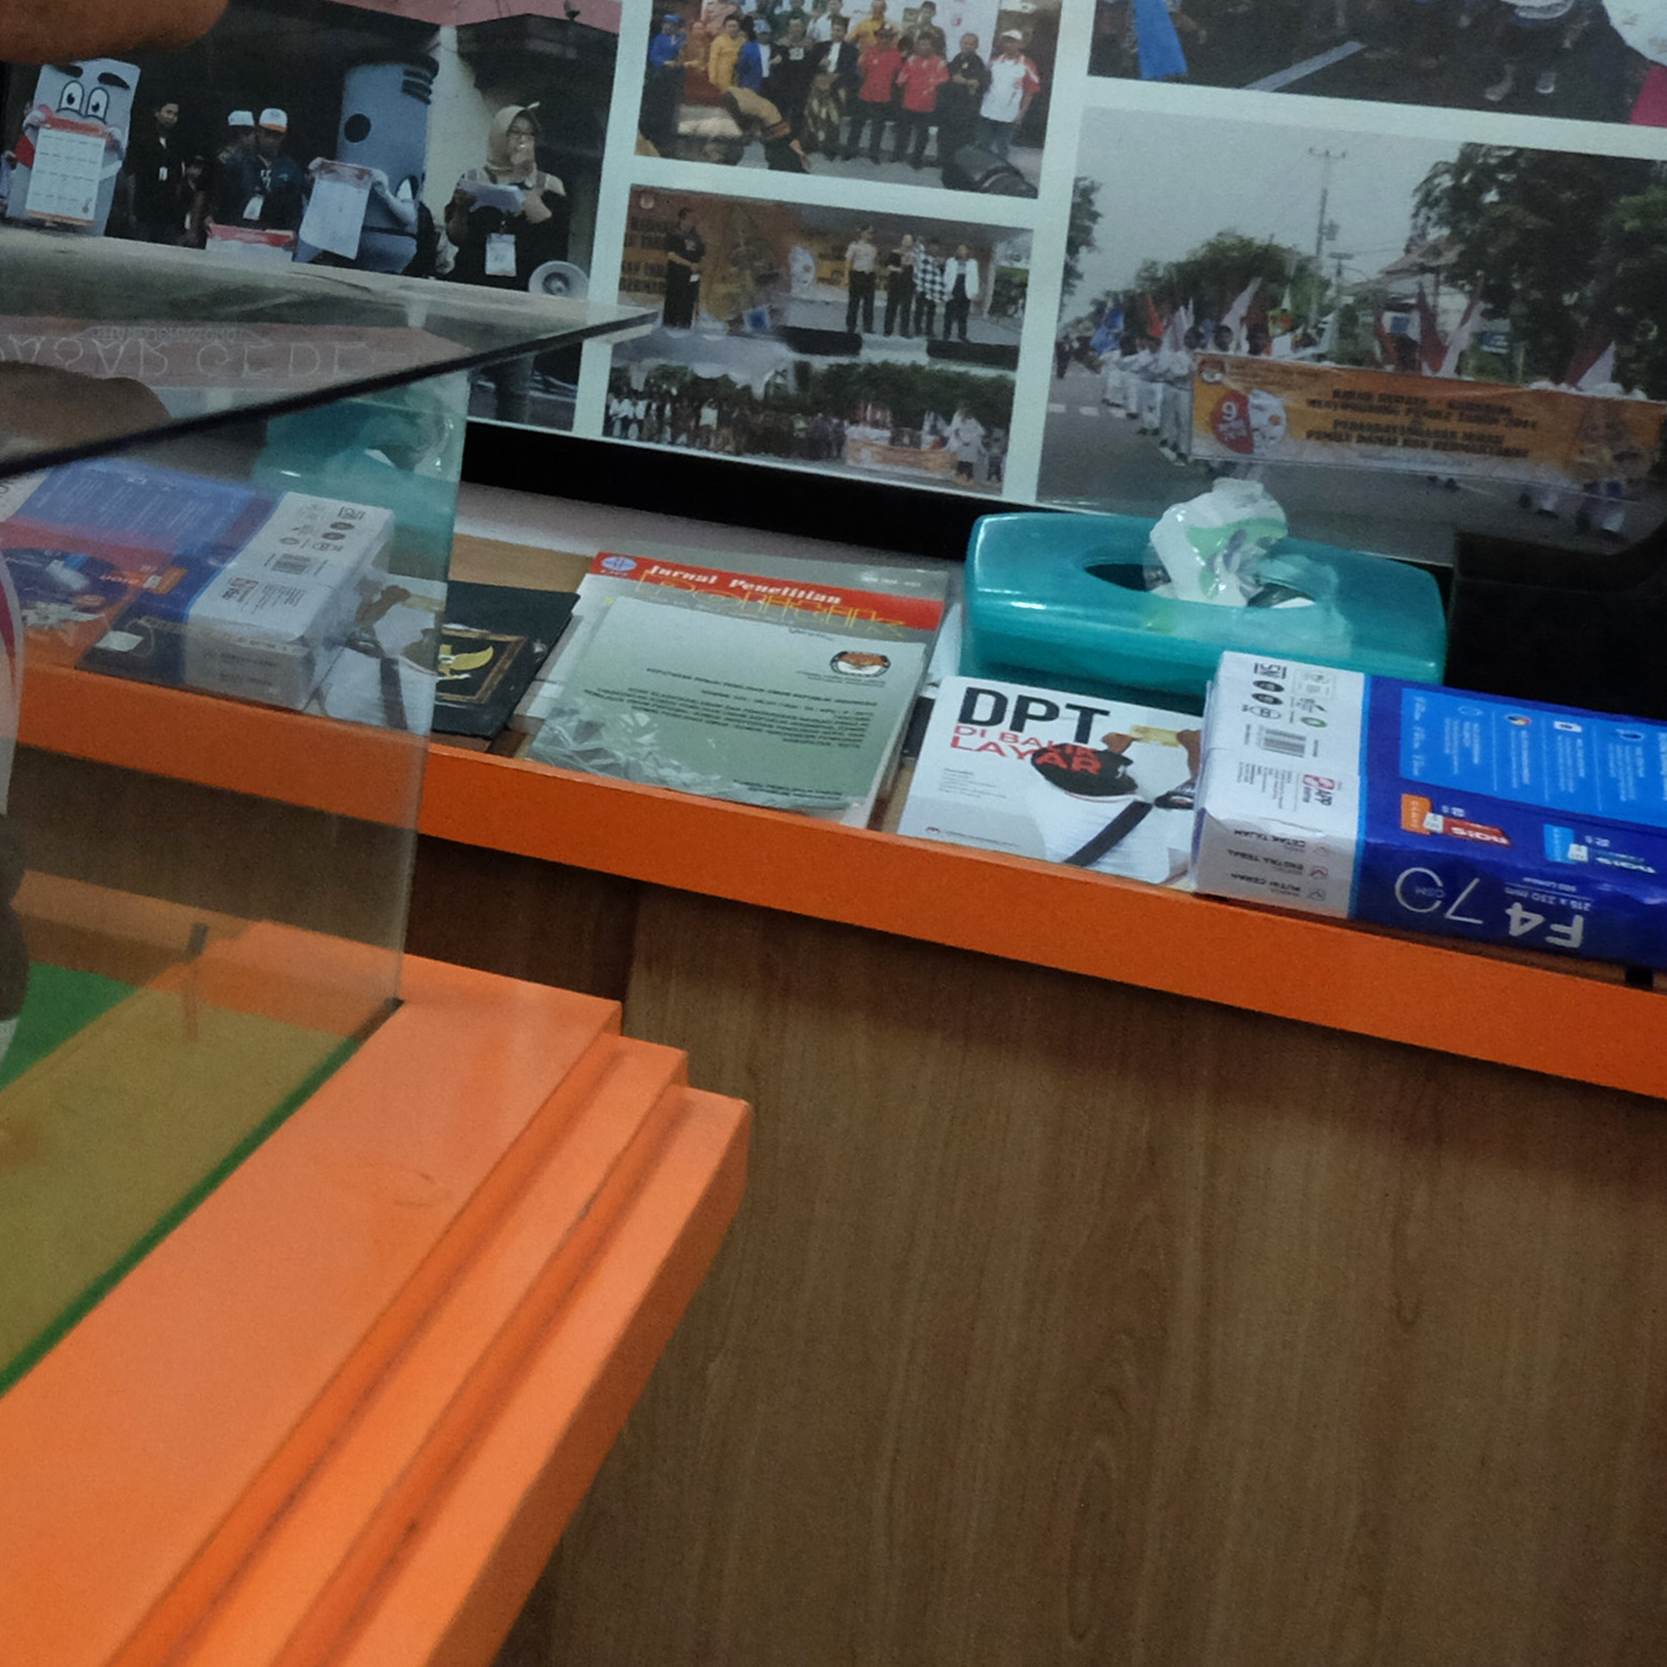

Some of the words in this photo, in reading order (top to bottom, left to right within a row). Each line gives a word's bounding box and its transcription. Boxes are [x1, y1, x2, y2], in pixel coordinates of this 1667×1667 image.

[1222, 401, 1238, 421] 9
[648, 564, 719, 586] Jurnal
[728, 577, 843, 607] Penelitian
[954, 725, 987, 737] DI
[957, 686, 1111, 746] DPT
[950, 735, 1103, 776] LAYAR
[1504, 901, 1586, 949] F4
